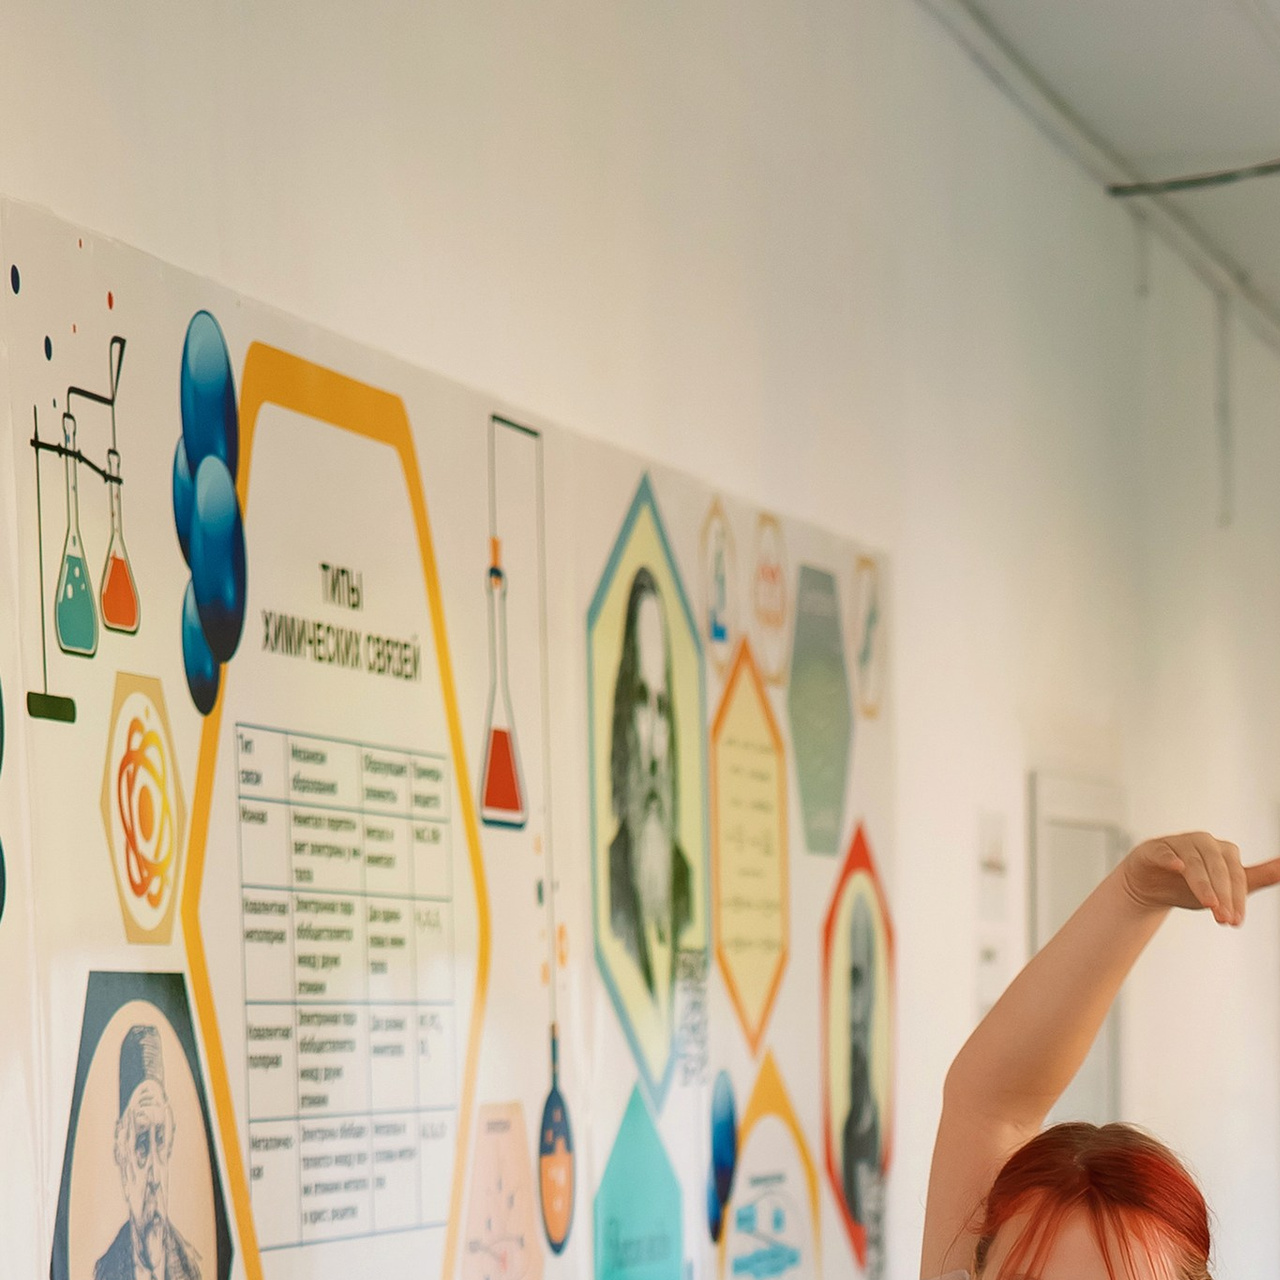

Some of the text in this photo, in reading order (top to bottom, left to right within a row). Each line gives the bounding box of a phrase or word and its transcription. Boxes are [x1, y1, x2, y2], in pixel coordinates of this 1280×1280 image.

[319, 561, 363, 610] ТИПЫ
[261, 609, 422, 681] ХИМИЧЕСКИХ СВЯЗЕЙ
